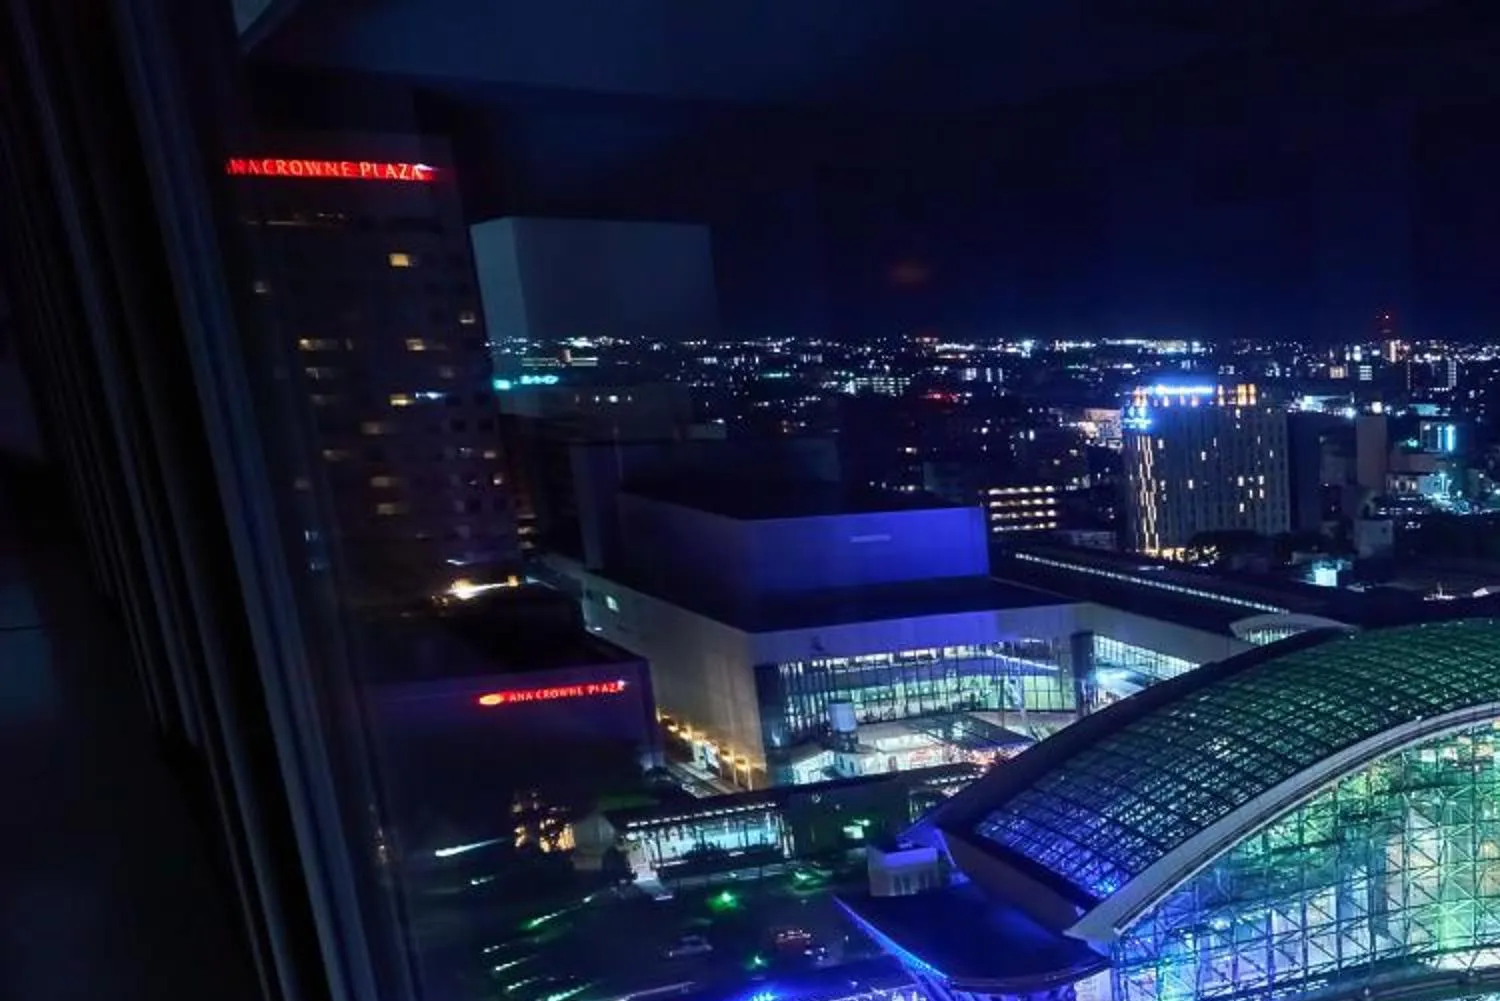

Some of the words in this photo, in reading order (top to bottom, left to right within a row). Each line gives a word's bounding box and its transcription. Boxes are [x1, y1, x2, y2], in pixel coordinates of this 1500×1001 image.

[262, 159, 352, 177] CROWNE
[359, 162, 427, 180] PLAZA
[510, 692, 533, 702] ANA
[535, 687, 585, 699] CROWNE
[588, 680, 625, 694] PLAZA
